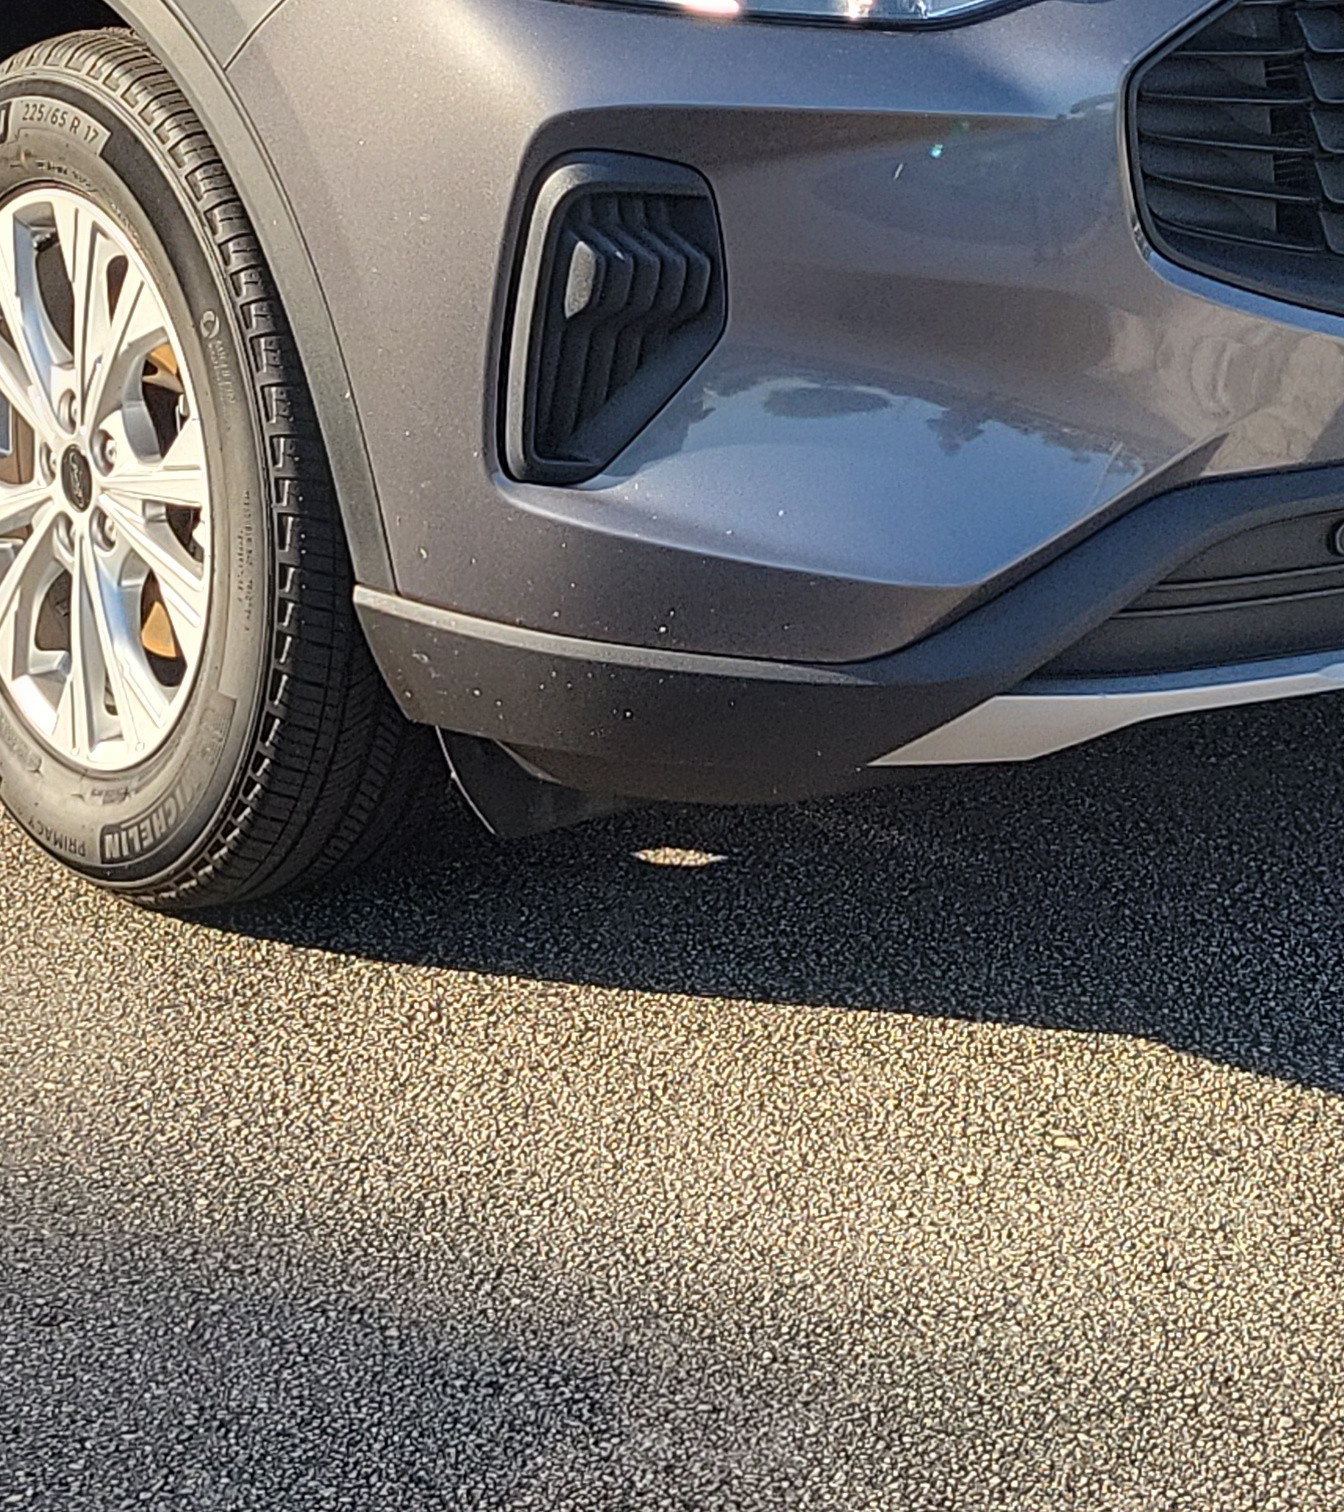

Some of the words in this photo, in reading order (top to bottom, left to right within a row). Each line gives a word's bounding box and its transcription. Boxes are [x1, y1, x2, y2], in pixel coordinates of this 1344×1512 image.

[22, 103, 68, 127] 225/65
[68, 117, 82, 135] R
[83, 125, 100, 145] 17
[28, 816, 86, 857] PRIMACY
